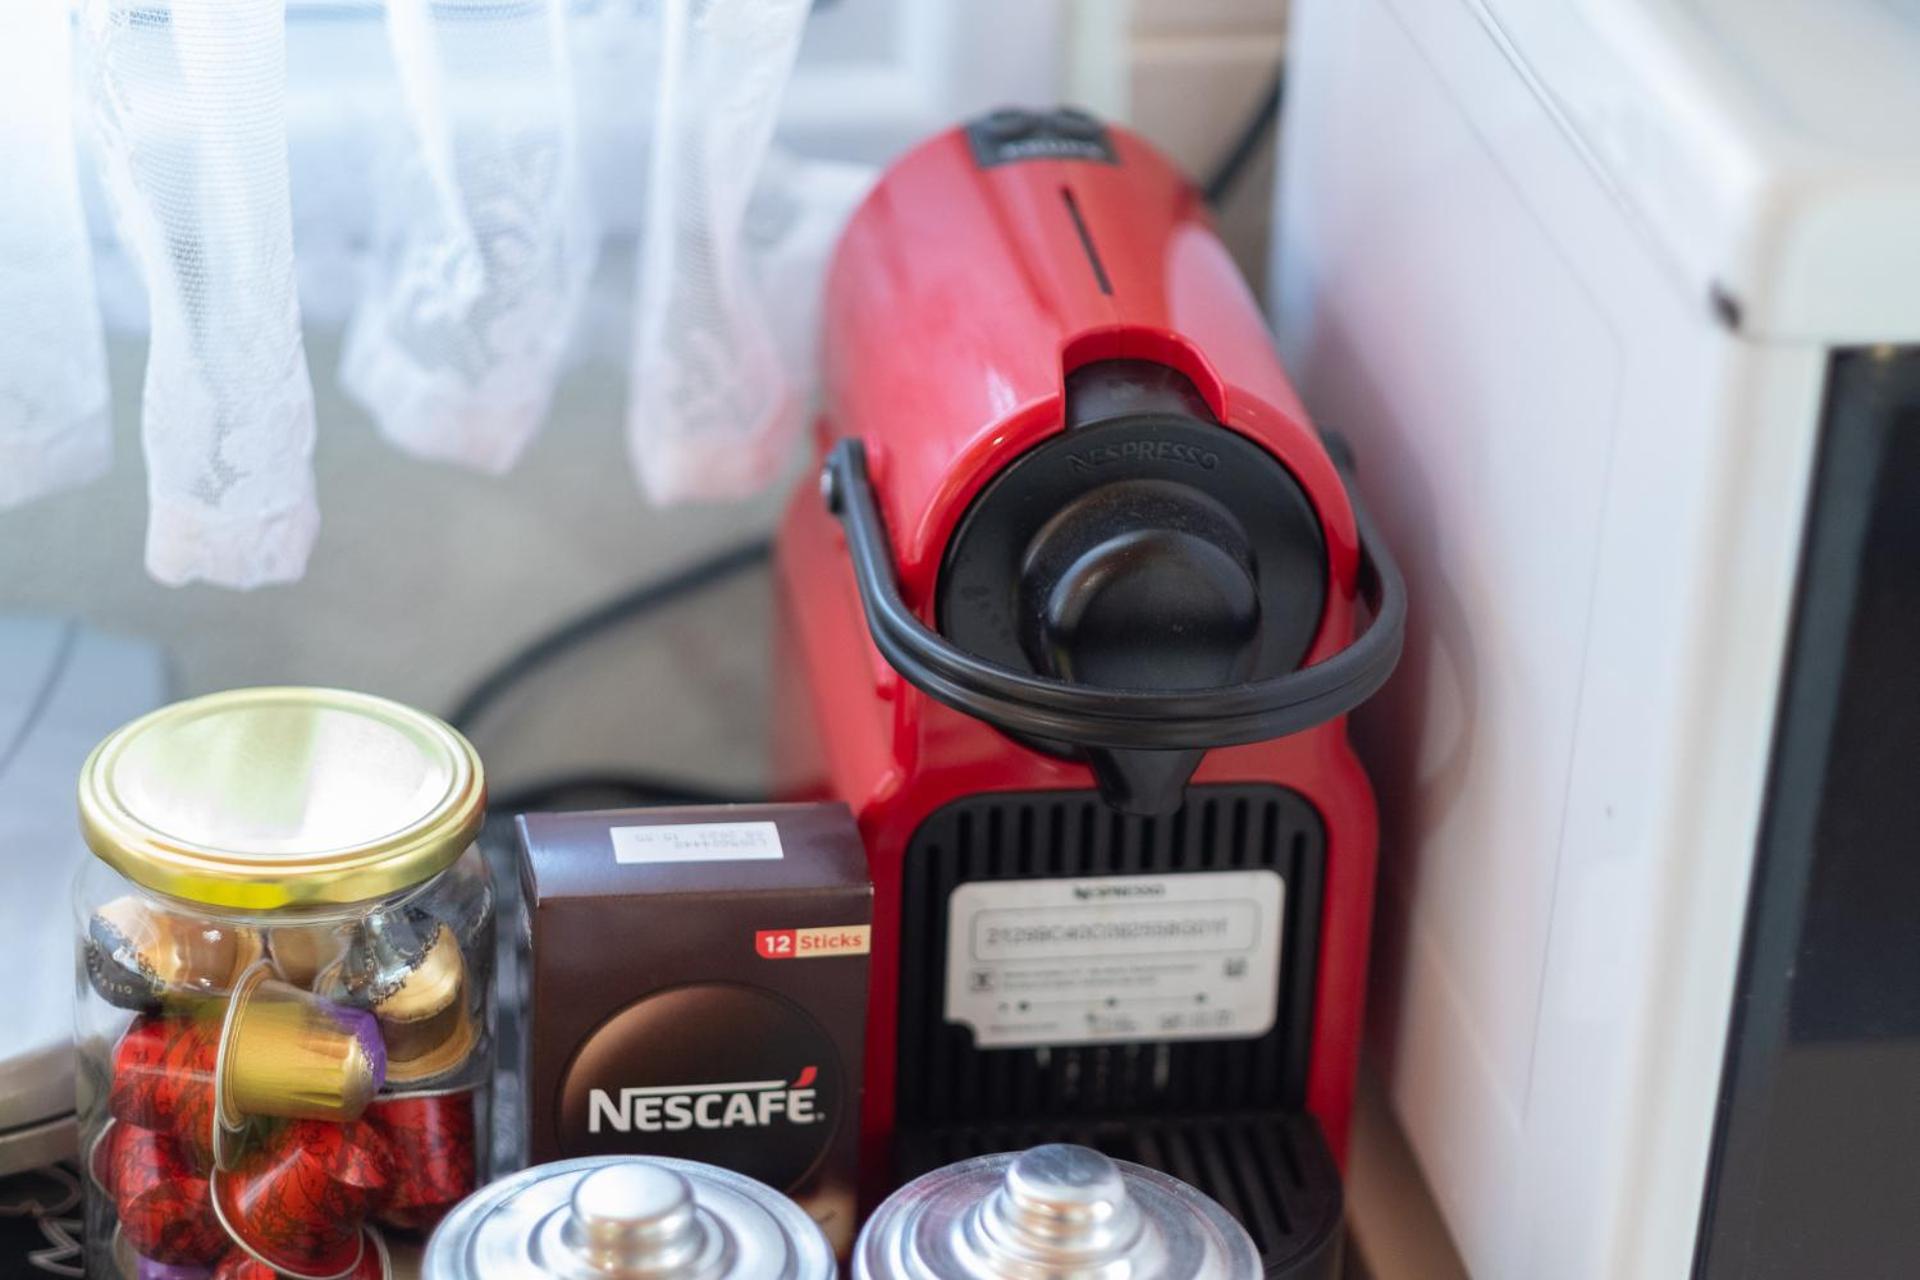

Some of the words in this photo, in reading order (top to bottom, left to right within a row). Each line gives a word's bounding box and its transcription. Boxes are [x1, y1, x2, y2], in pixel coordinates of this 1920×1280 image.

[1065, 437, 1220, 471] NESPRESSO
[765, 935, 791, 953] 12
[801, 934, 862, 949] Sticks
[588, 1066, 818, 1133] NESCAFÉ
